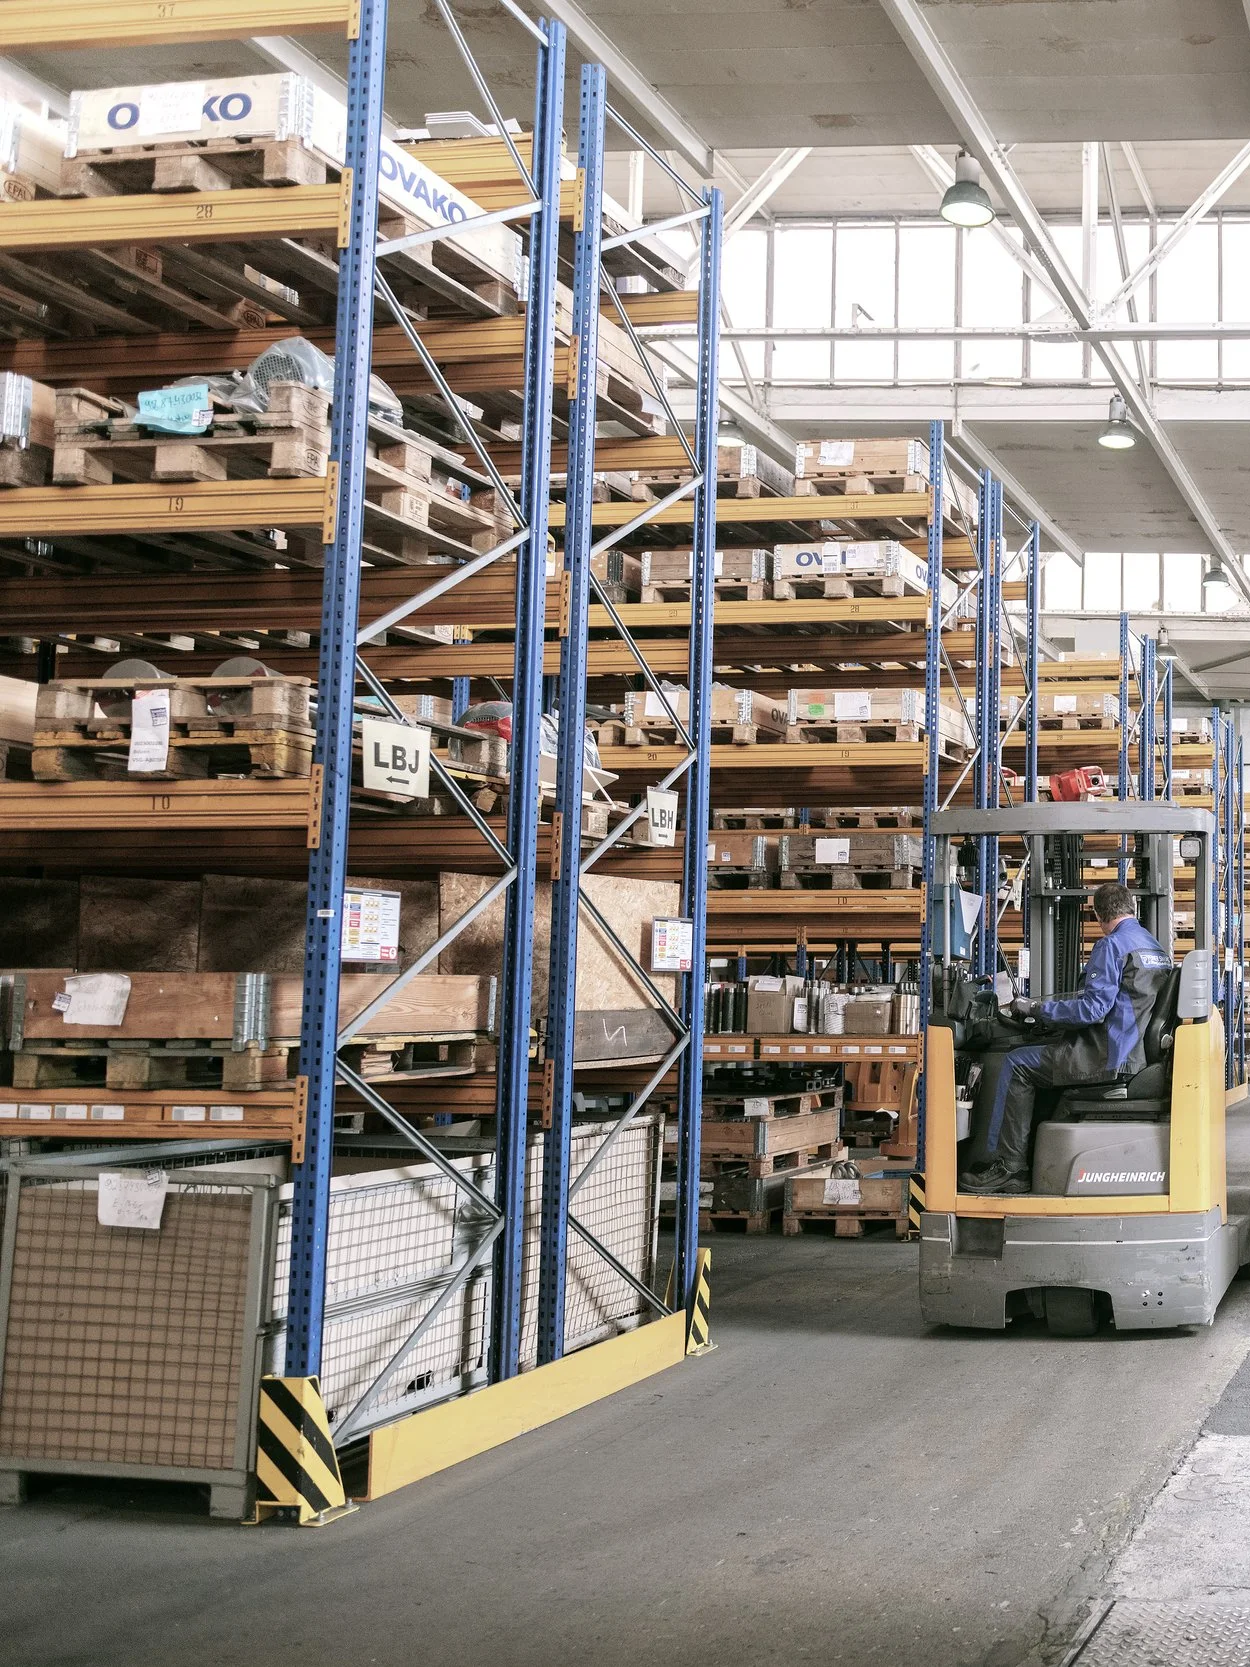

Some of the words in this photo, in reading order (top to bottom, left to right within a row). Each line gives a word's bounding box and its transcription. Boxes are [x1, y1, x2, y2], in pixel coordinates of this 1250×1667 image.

[107, 92, 252, 130] OKO
[196, 204, 213, 219] 28
[168, 495, 184, 511] 19
[373, 741, 420, 774] LBJ
[647, 752, 657, 761] 20
[151, 795, 171, 810] 10
[651, 807, 674, 830] LBH
[1077, 1170, 1166, 1183] JUNGHEINRICH
